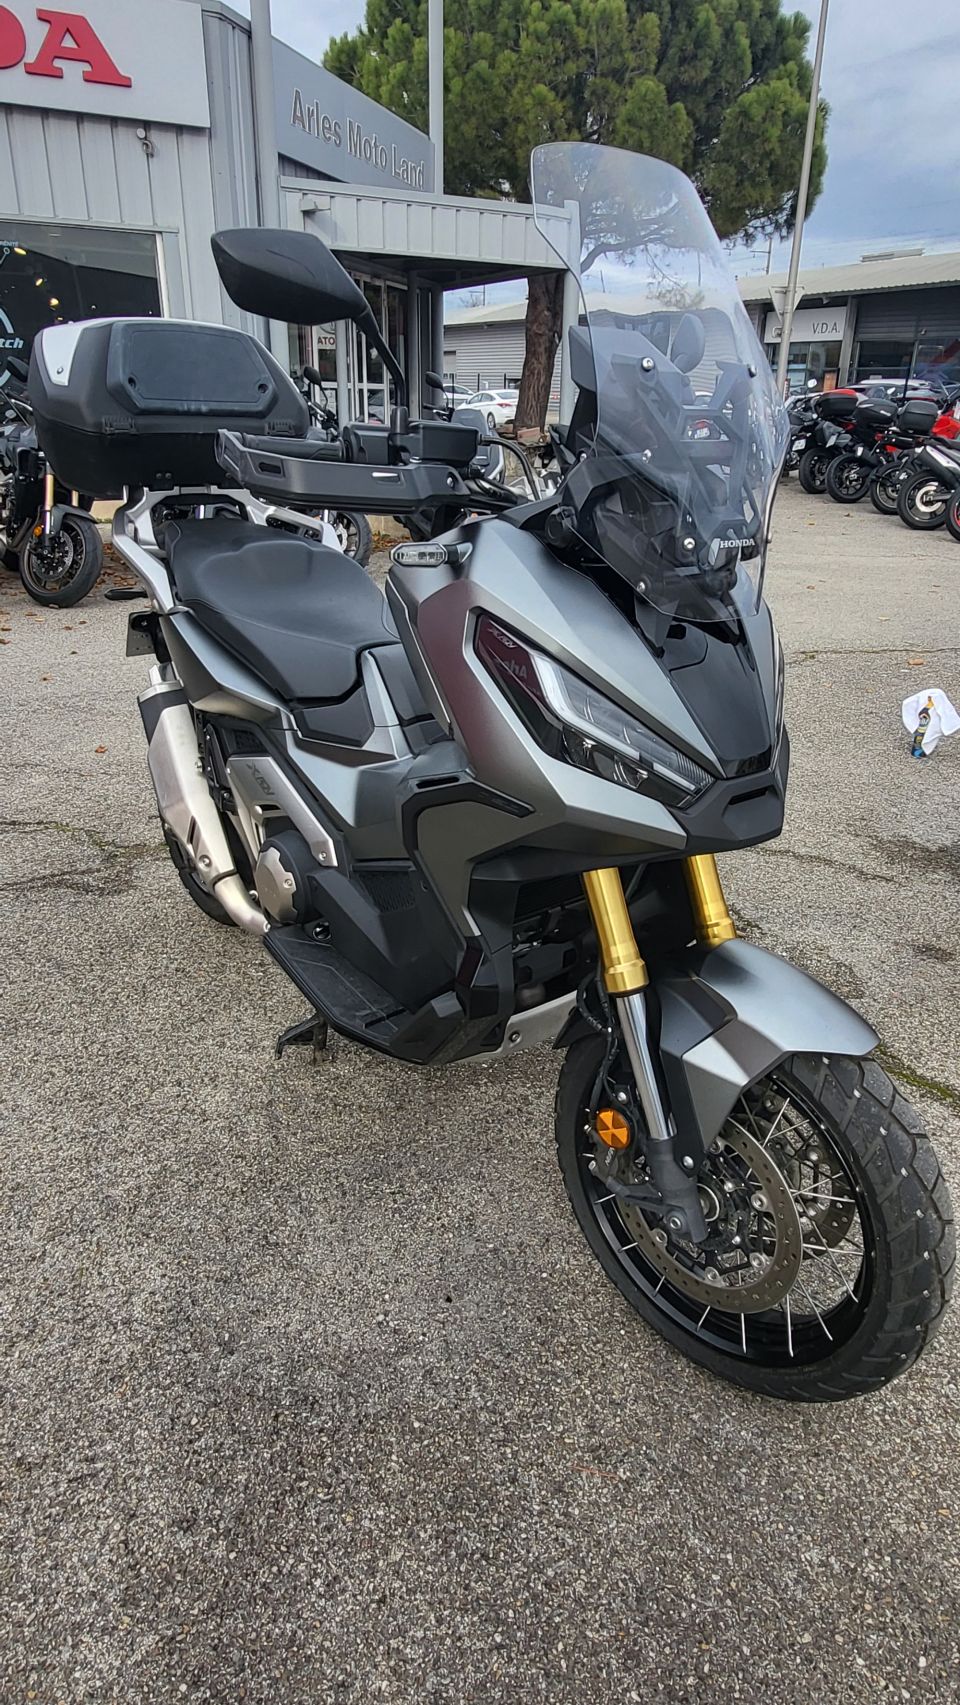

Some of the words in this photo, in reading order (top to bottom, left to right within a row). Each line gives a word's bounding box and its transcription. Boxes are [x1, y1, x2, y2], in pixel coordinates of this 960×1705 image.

[290, 87, 342, 148] Arles
[346, 117, 388, 170] Moto
[391, 143, 425, 190] Land
[812, 321, 841, 335] V.D.A.
[719, 537, 756, 549] HONDA
